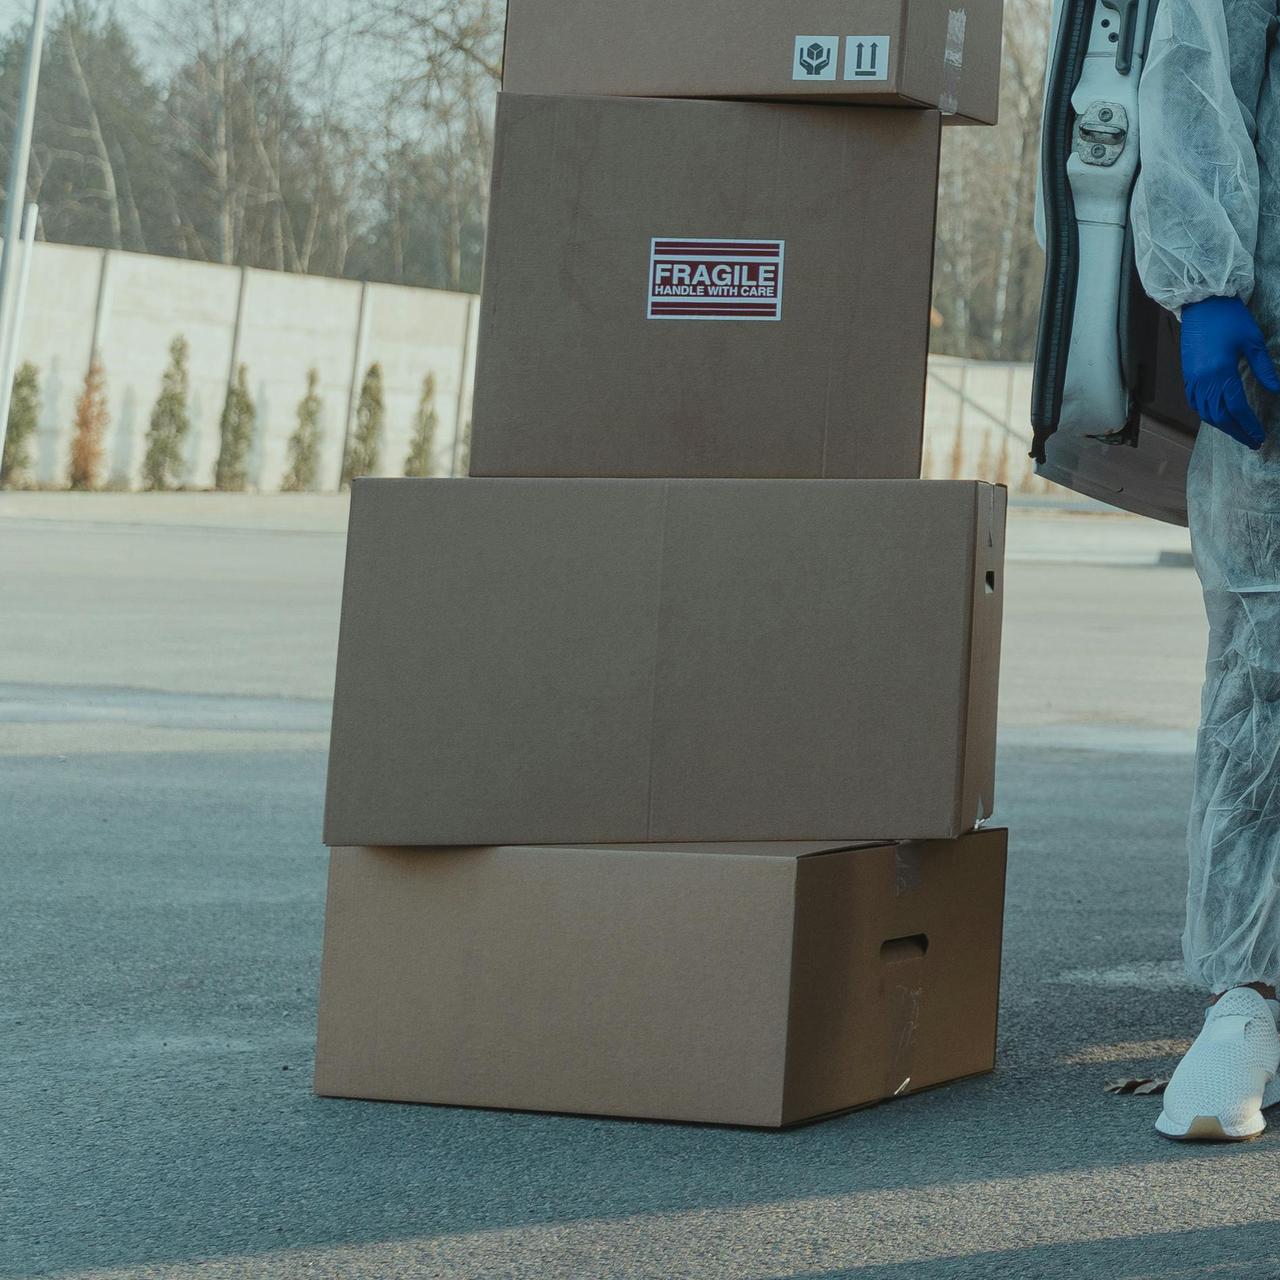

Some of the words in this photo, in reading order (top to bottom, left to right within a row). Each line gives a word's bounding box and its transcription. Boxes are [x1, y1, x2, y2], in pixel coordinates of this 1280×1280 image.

[655, 264, 775, 286] FRAGILE
[655, 285, 705, 295] HANDLE
[707, 286, 738, 296] WITH
[741, 286, 774, 296] CARE
